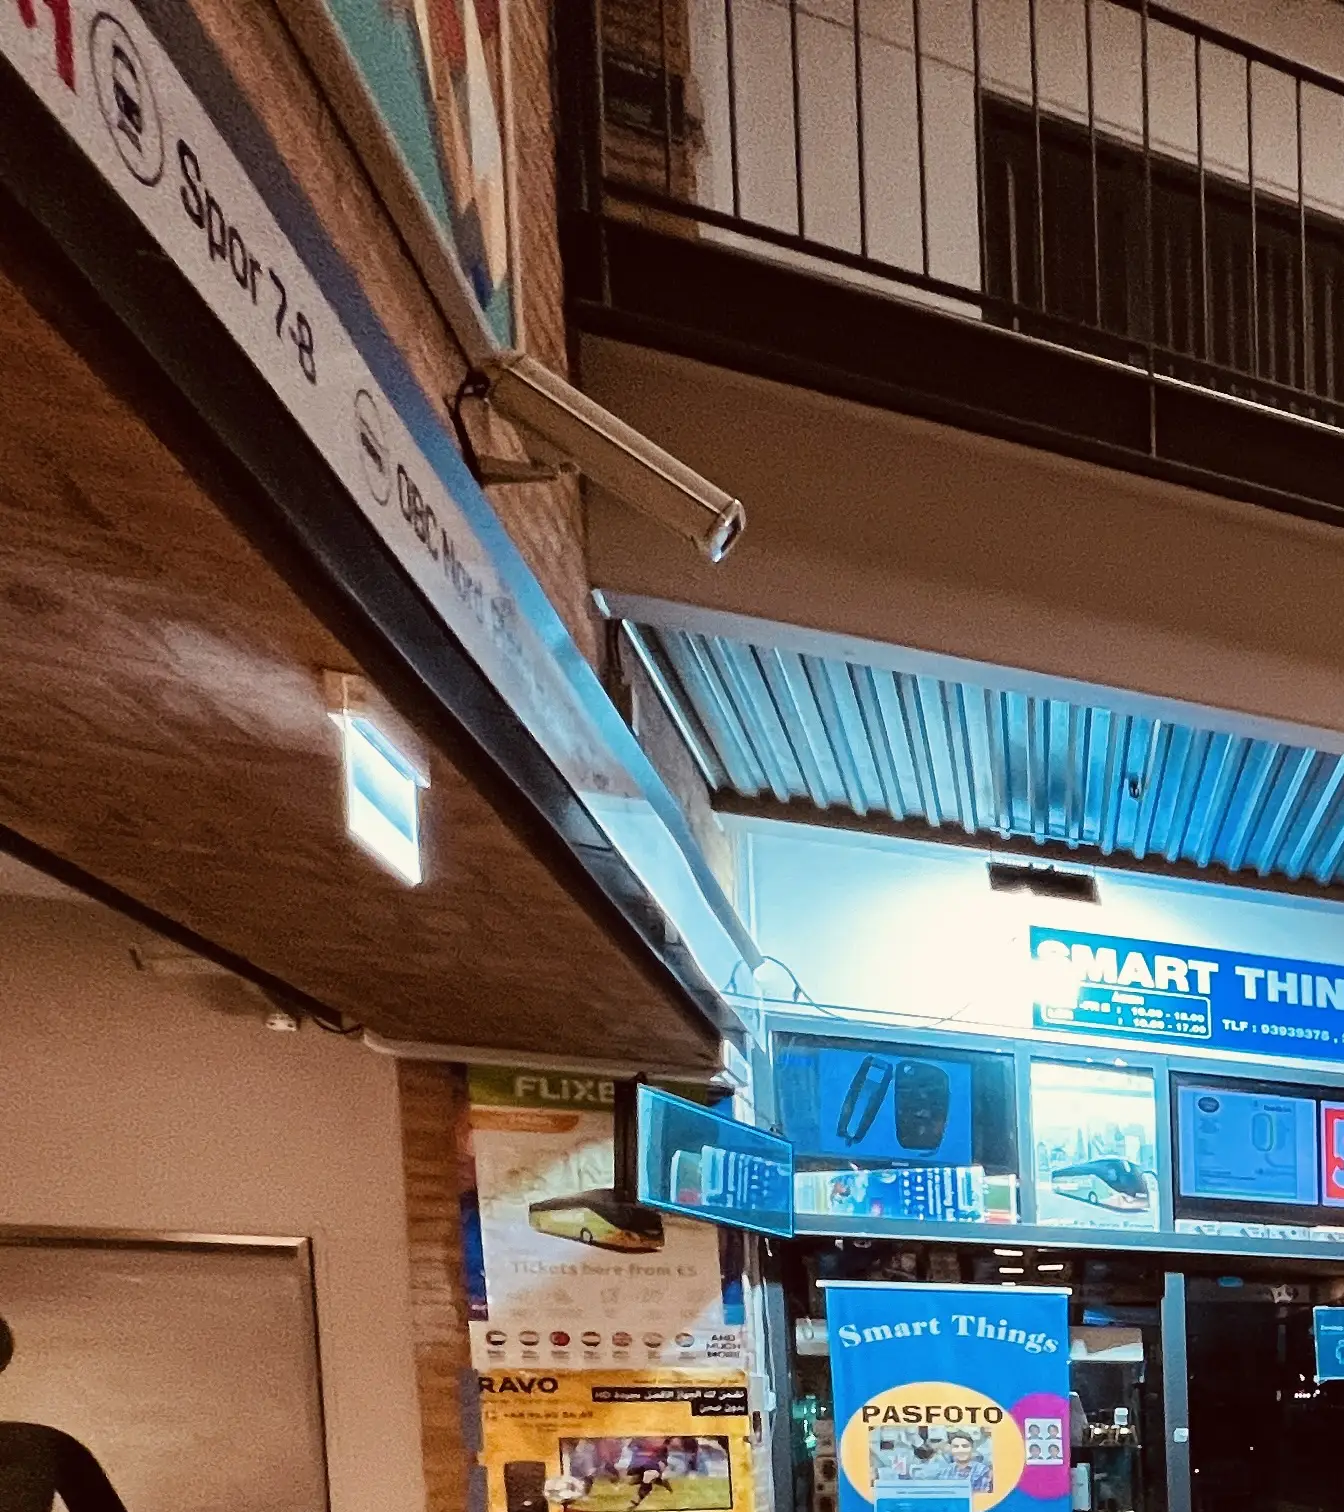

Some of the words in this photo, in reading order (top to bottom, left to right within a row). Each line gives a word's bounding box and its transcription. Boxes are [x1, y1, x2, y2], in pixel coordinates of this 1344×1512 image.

[177, 139, 264, 305] Spor
[1221, 1018, 1249, 1032] TLF
[510, 1260, 578, 1276] Tickets
[628, 1261, 671, 1277] from
[838, 1316, 941, 1348] Smart
[951, 1314, 1059, 1354] Things
[479, 1376, 559, 1394] RAVO
[861, 1405, 1004, 1425] PASFOTO
